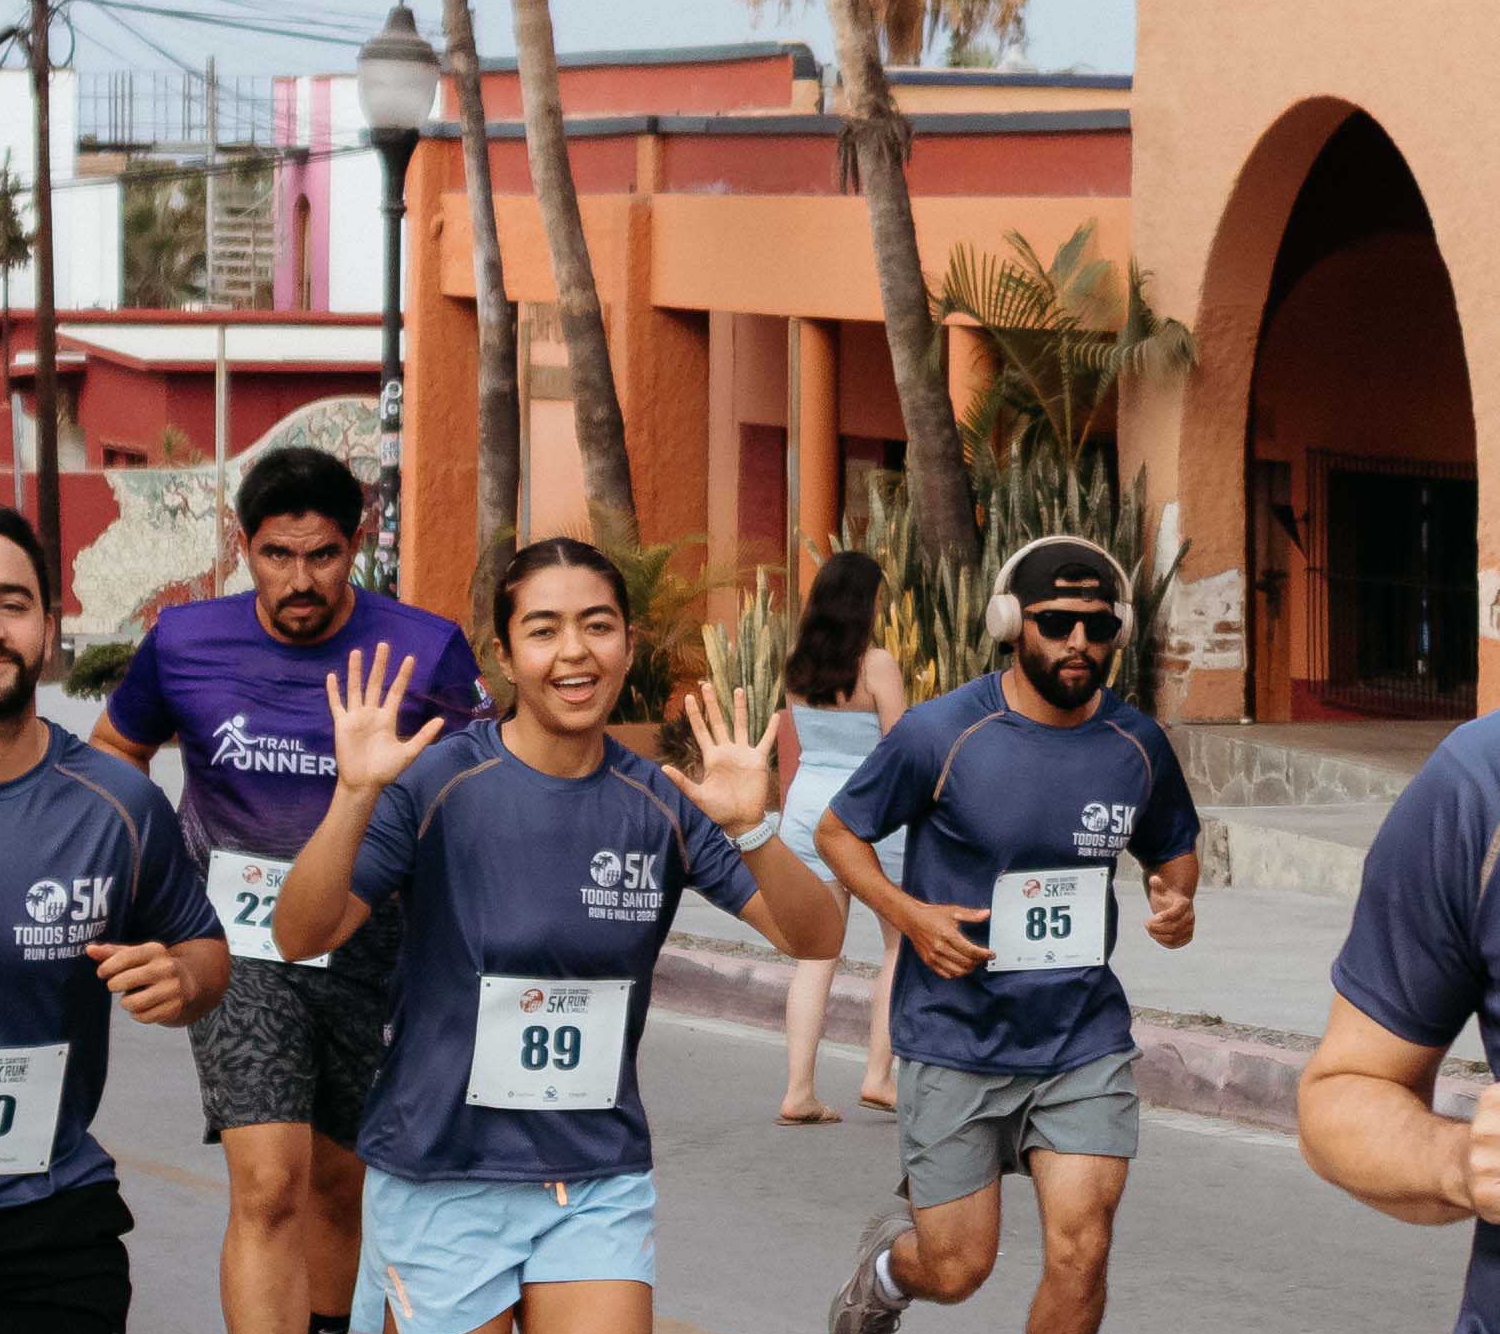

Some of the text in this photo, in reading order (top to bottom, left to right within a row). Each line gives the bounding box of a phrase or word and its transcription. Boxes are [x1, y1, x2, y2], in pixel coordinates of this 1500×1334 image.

[258, 737, 305, 752] TRAIL
[1110, 804, 1136, 835] 5K
[1072, 832, 1106, 847] TODOS
[623, 853, 658, 890] 5K
[71, 876, 113, 921] 5K
[580, 888, 619, 907] TODOS
[1026, 905, 1072, 941] 85
[13, 926, 64, 945] TODOS
[24, 947, 46, 961] RUN
[48, 948, 56, 960] &
[546, 995, 568, 1014] 5K
[521, 1025, 582, 1071] 89
